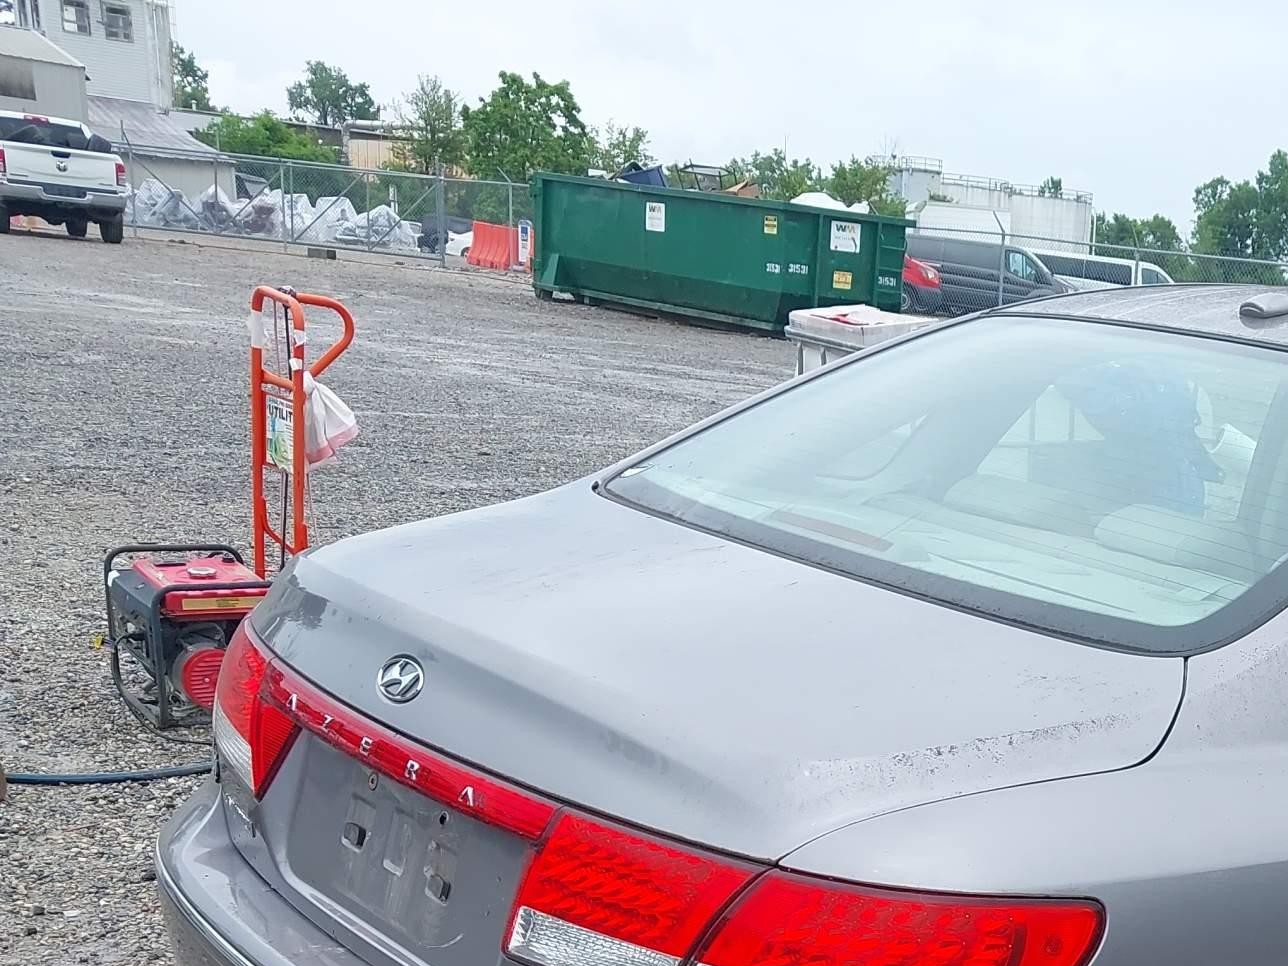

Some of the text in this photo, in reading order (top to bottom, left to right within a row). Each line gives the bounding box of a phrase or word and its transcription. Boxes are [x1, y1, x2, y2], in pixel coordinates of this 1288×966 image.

[835, 223, 857, 234] WM
[788, 263, 809, 275] 31531
[878, 276, 897, 287] 31531
[268, 403, 293, 422] UTILIT
[285, 692, 476, 808] AZERA
